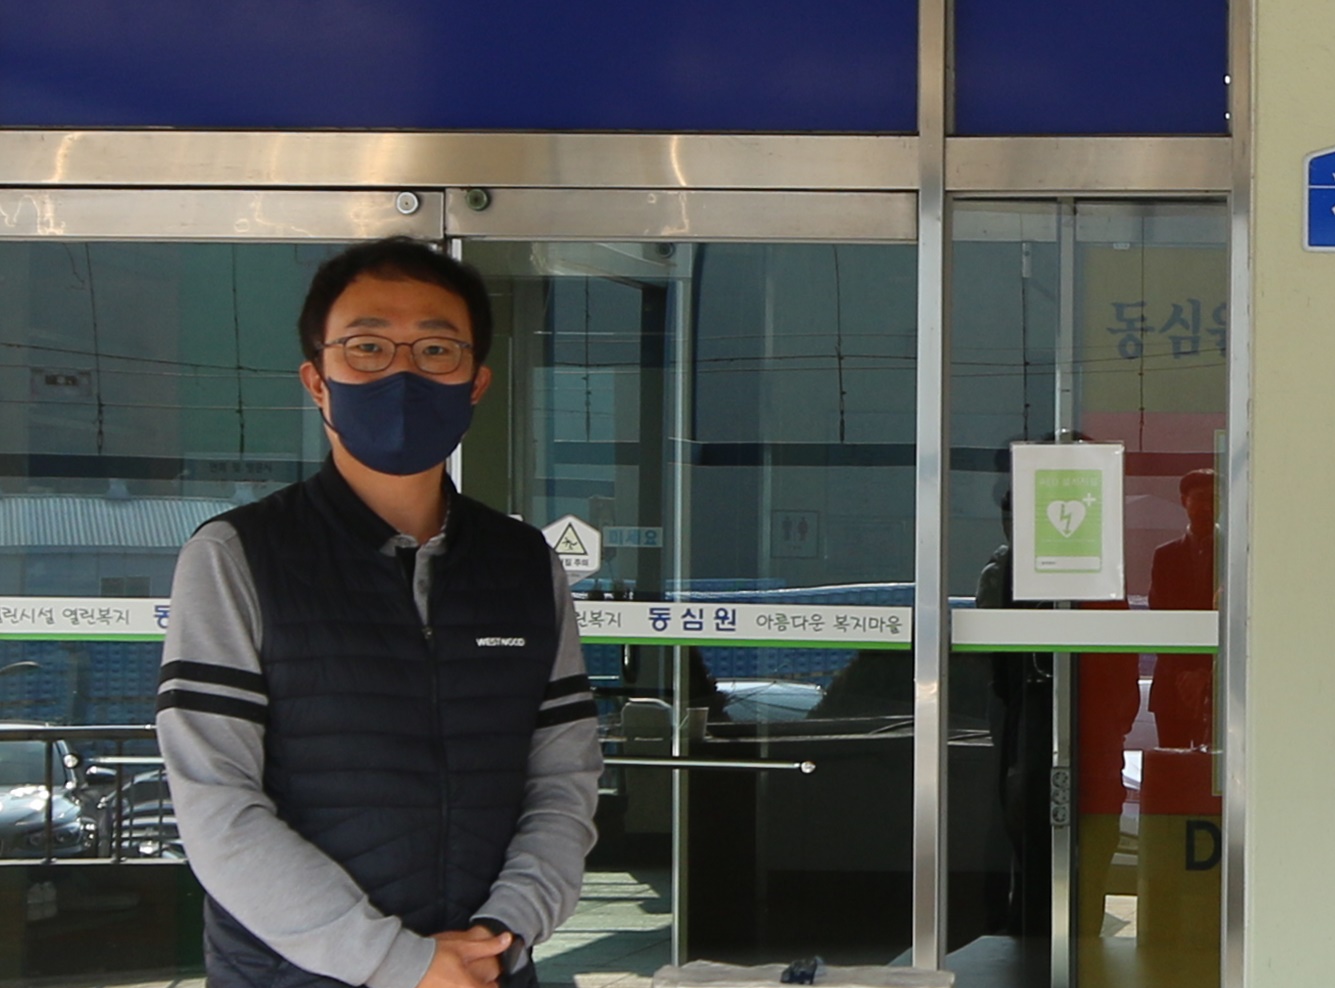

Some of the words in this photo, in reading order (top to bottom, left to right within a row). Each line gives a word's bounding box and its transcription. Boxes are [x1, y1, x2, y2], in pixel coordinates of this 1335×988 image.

[0, 607, 55, 625] 린시설
[62, 607, 130, 625] 열린복지
[756, 613, 825, 632] 아름다운
[833, 614, 902, 634] 복지마을
